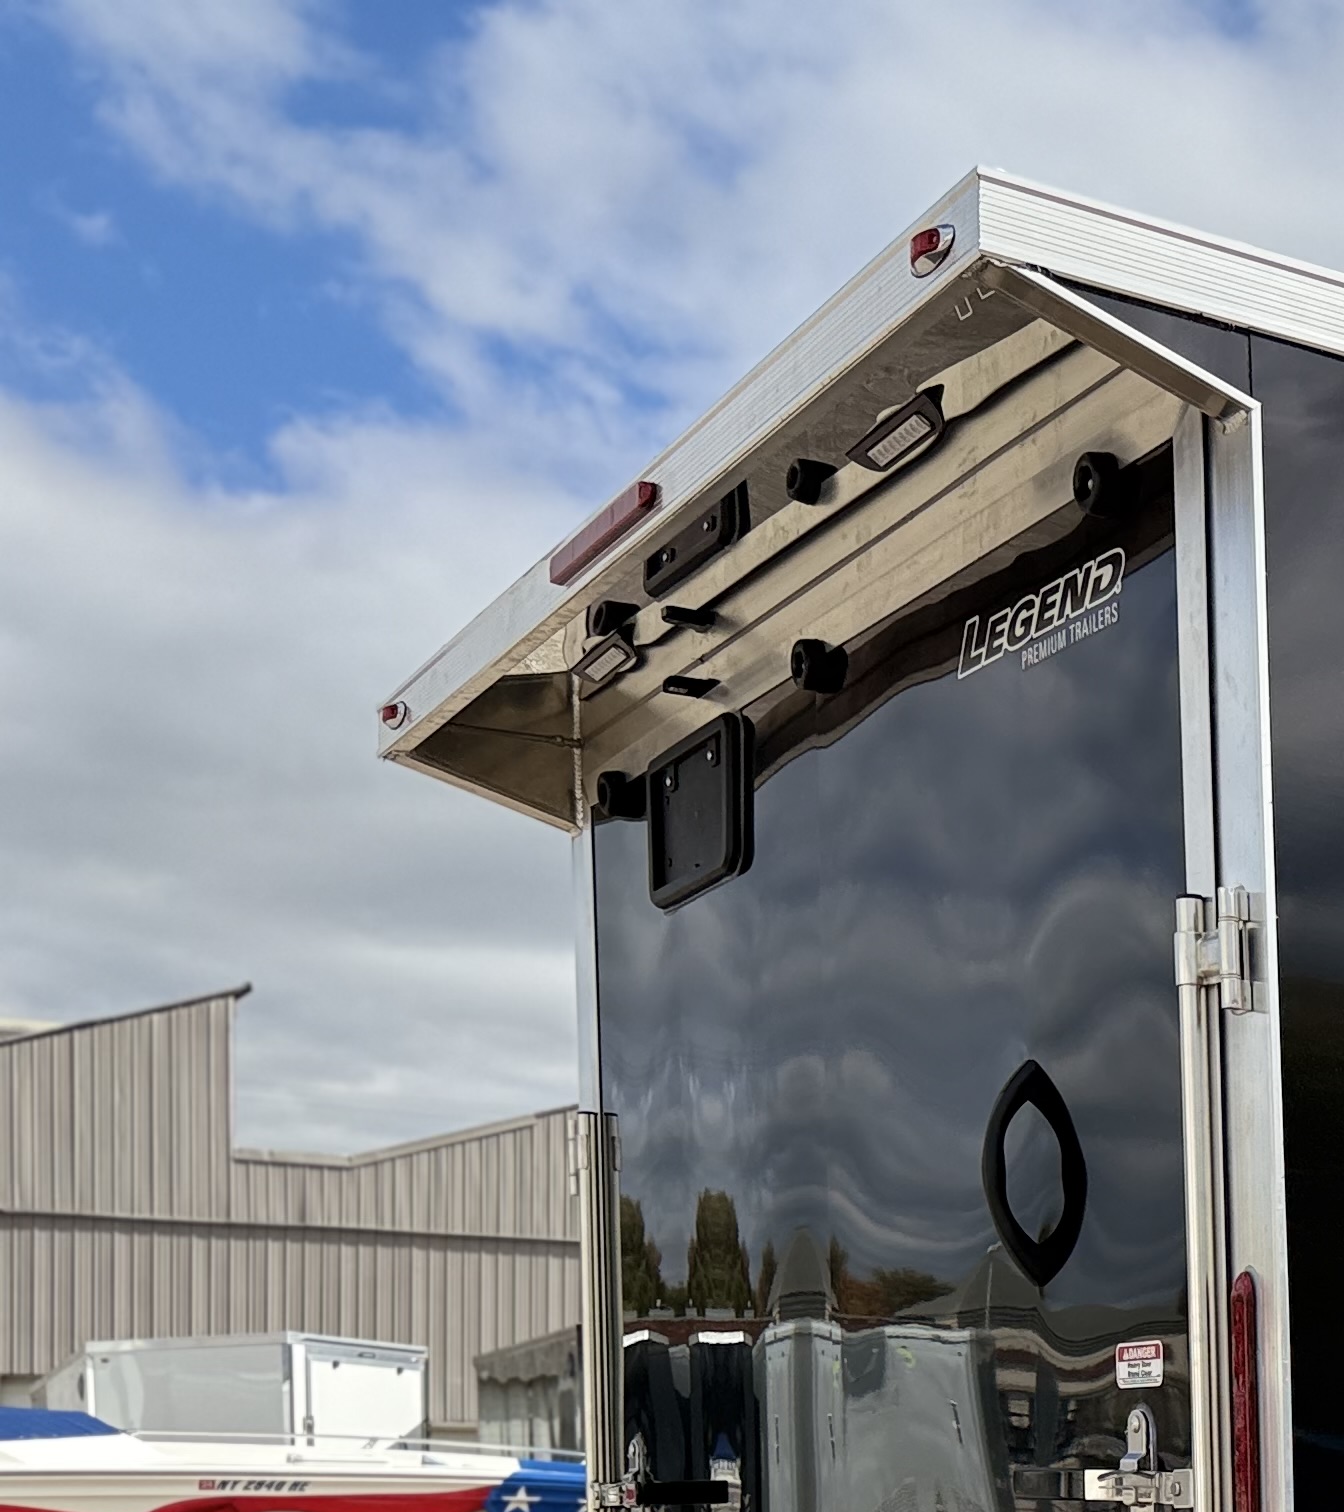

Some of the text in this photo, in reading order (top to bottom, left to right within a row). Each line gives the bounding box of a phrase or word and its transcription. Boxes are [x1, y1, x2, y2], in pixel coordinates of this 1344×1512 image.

[957, 547, 1125, 680] LEGEND
[1021, 602, 1119, 671] PREMIUM TRAILERS
[1128, 1346, 1157, 1360] DANGER
